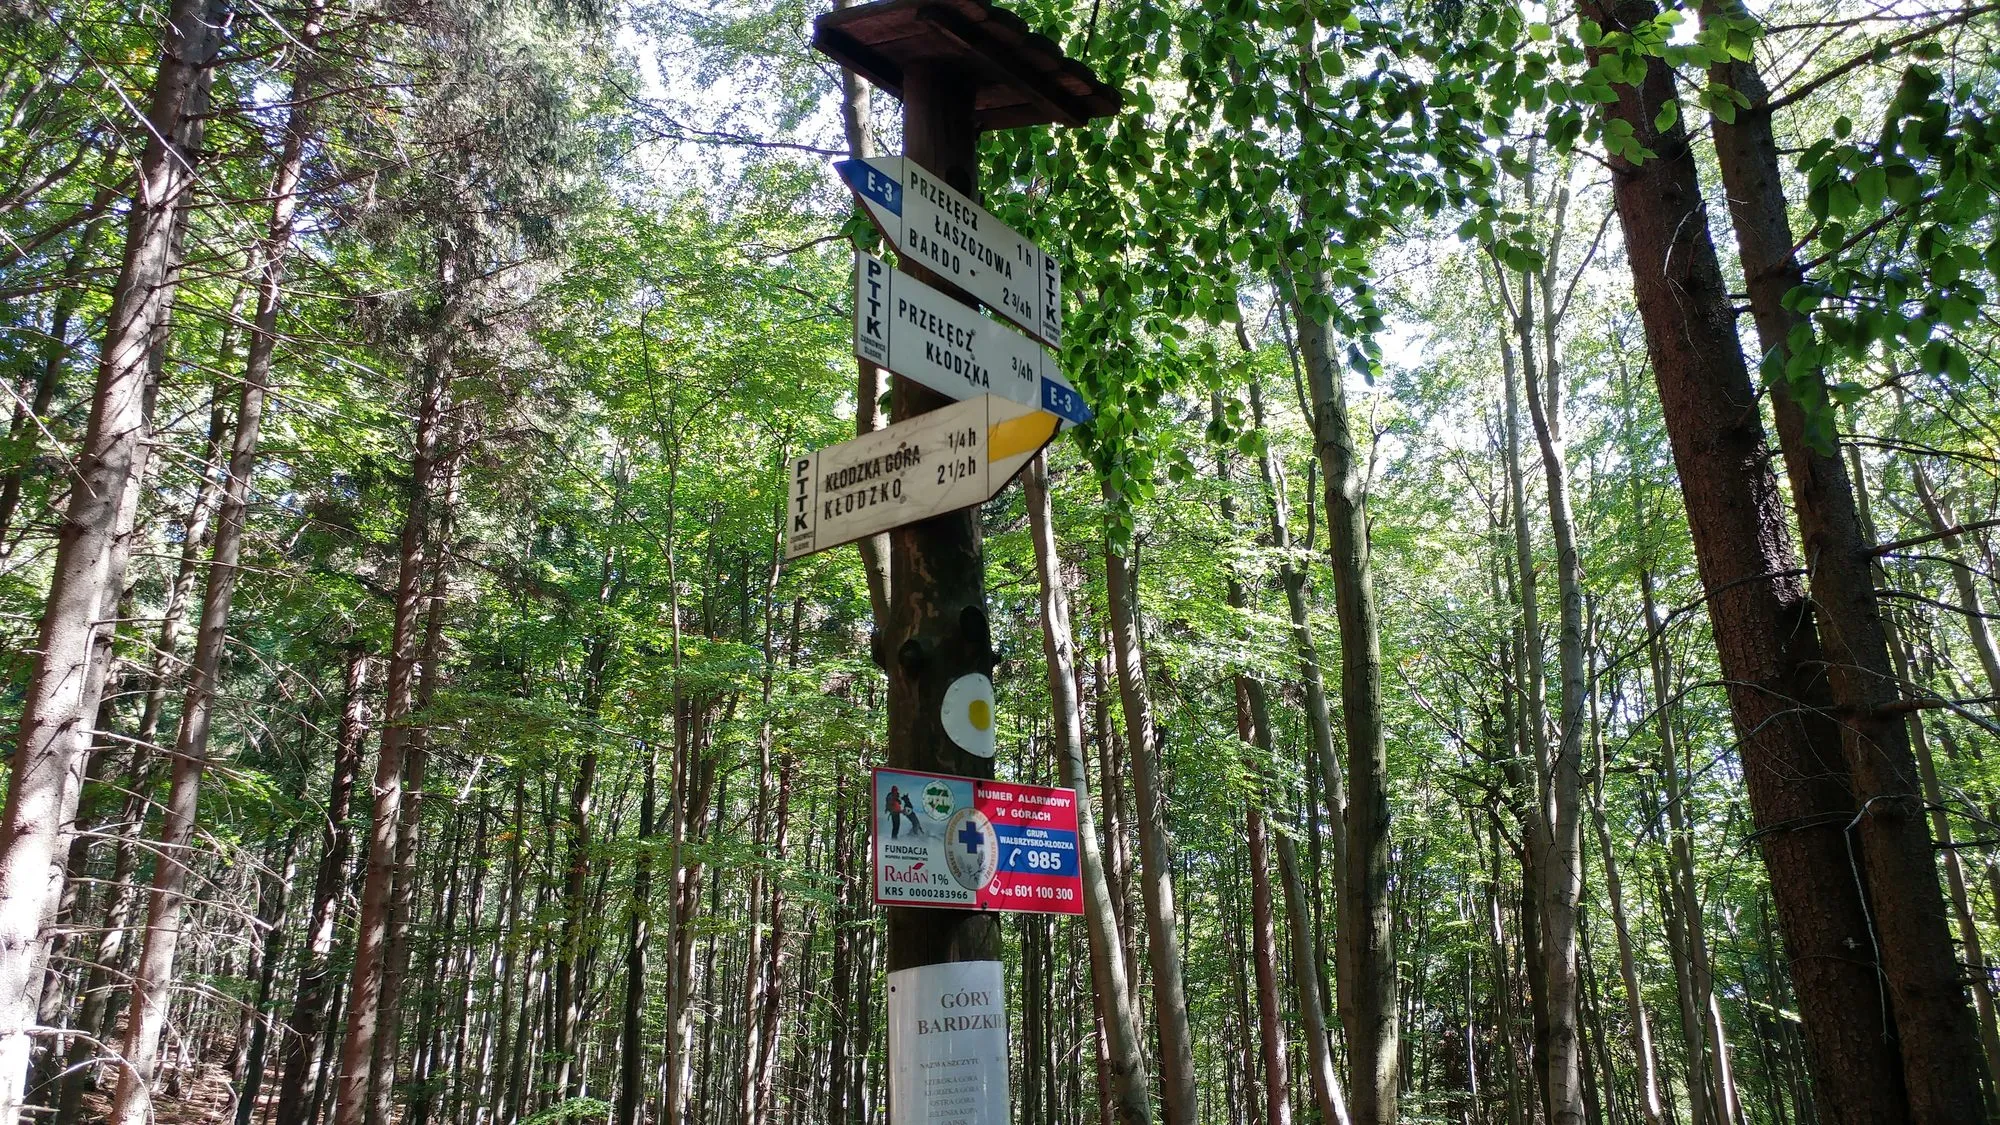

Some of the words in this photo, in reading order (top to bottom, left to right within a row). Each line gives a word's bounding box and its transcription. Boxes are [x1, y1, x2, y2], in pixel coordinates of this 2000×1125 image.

[867, 171, 893, 202] E-3
[910, 171, 978, 231] PRZEŁĘCZ
[910, 228, 960, 275] BARDO
[935, 214, 1012, 281] ŁASZCZOWA
[899, 298, 973, 353] PRZEŁĘCZ
[926, 341, 990, 389] KŁODZKA
[1050, 386, 1072, 413] E-3
[825, 458, 880, 493] KŁODZKA
[885, 445, 920, 473] GÓRA
[824, 478, 901, 520] KŁODZKO
[977, 789, 1013, 802] NUMER
[1018, 794, 1071, 808] ALARMOWY
[996, 807, 1006, 817] W
[1011, 808, 1051, 822] GÓRACH
[1026, 829, 1049, 839] GRUPA
[885, 844, 928, 856] FUNDACJA
[1027, 850, 1062, 870] 985
[932, 873, 949, 886] 1%
[885, 886, 904, 896] KRS
[909, 888, 968, 899] 0000283966
[1015, 885, 1033, 898] 601
[1035, 886, 1054, 900] 100
[1056, 888, 1074, 901] 300
[941, 988, 992, 1009] GÓRY
